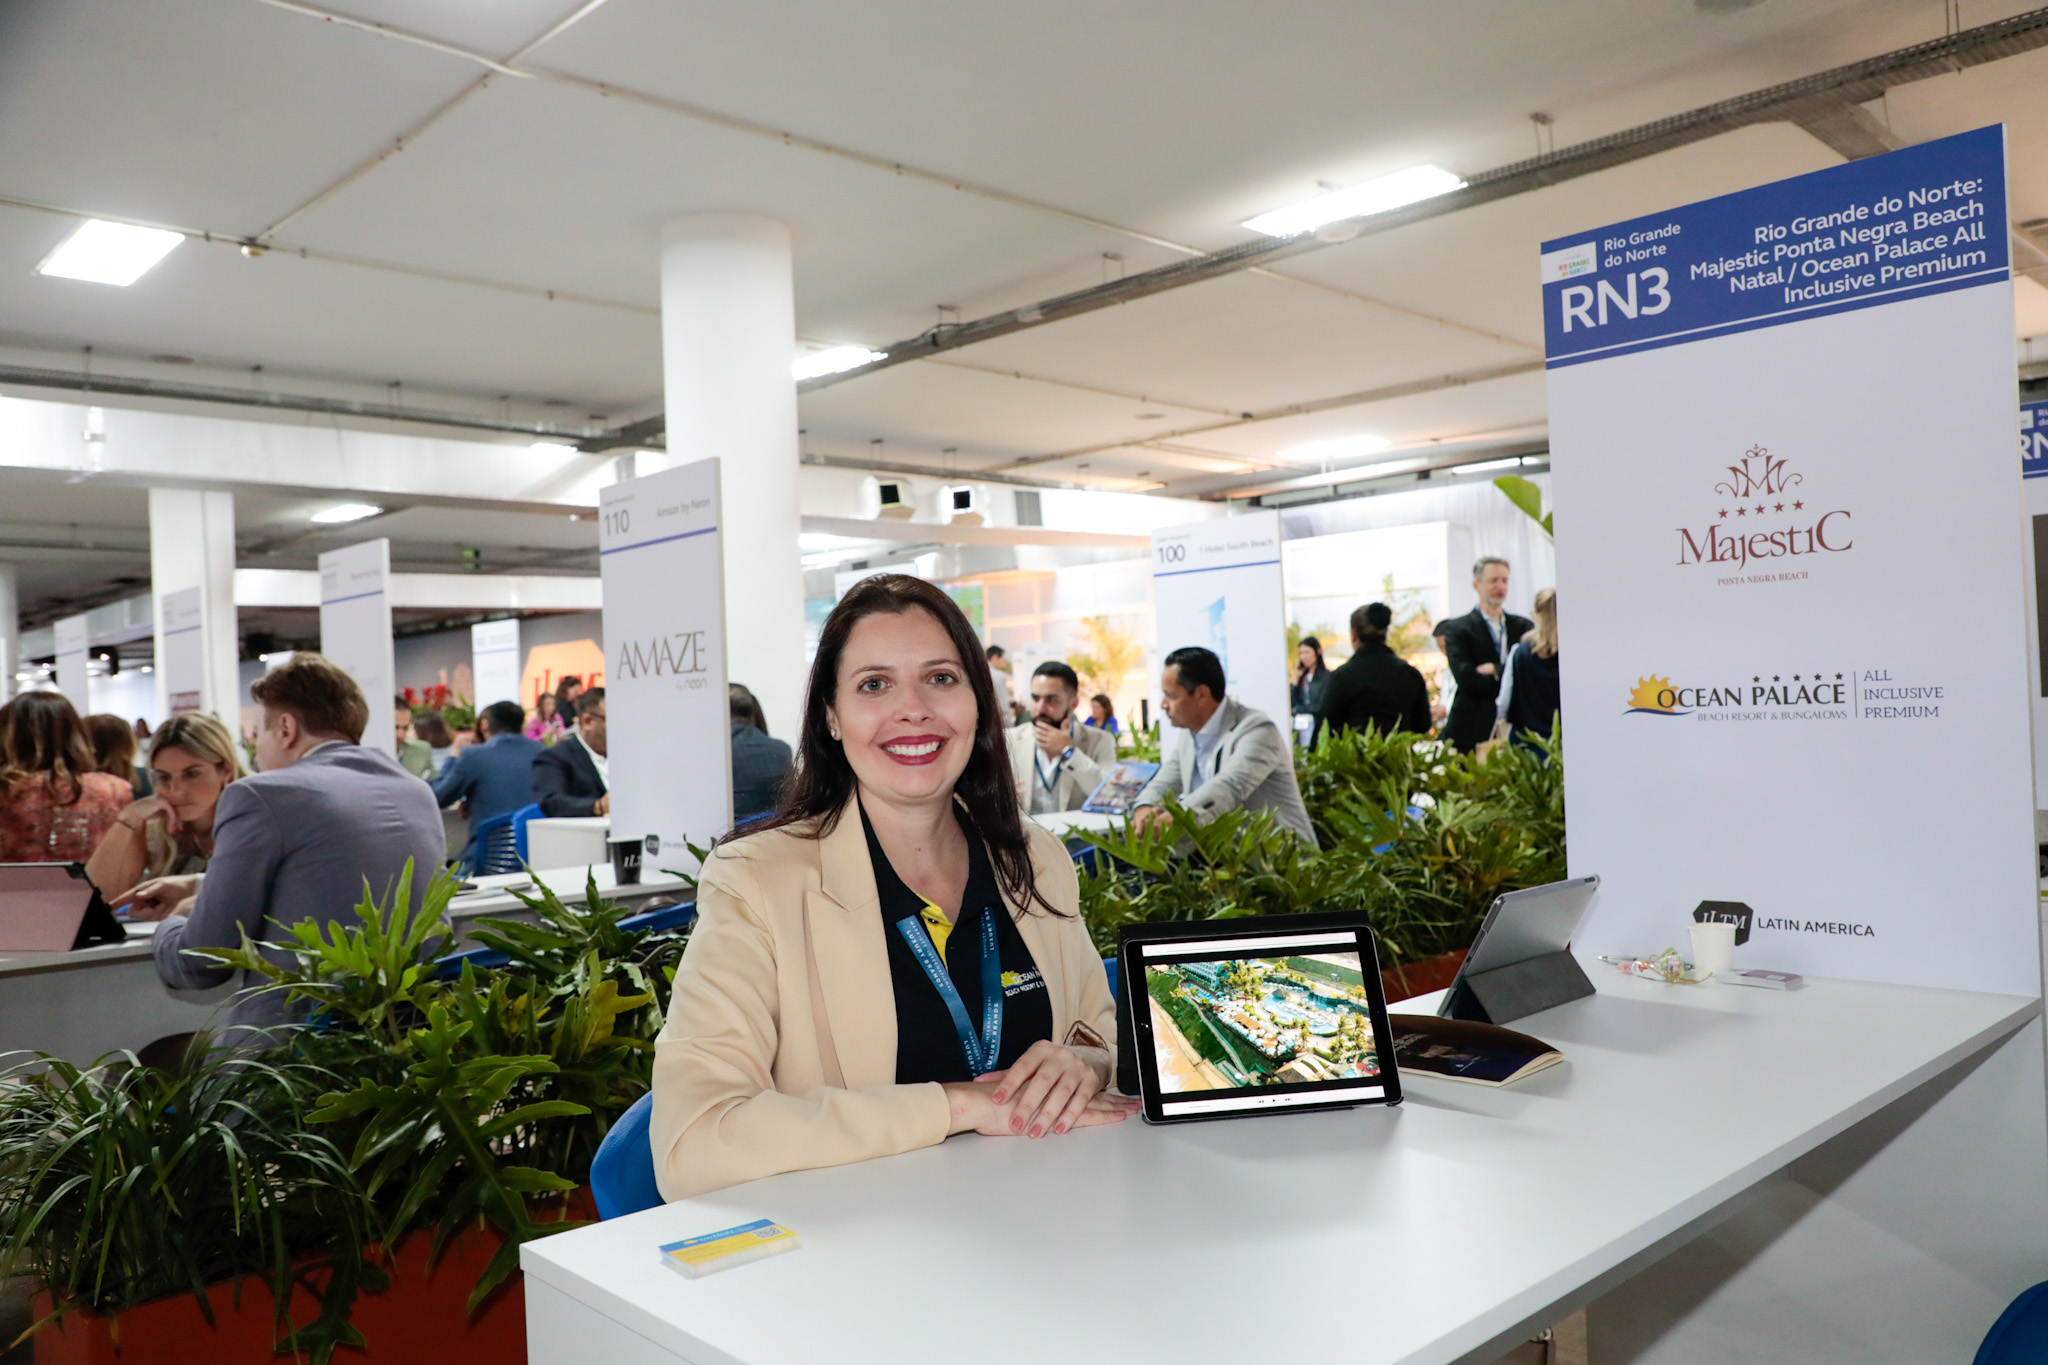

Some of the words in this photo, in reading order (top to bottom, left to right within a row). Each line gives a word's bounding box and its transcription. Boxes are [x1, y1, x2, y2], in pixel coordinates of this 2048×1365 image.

[1754, 223, 1788, 244] Rio
[1791, 203, 1869, 235] Grande
[1873, 196, 1903, 216] do
[1908, 178, 1984, 209] Norte:
[1604, 237, 1626, 252] Rio
[1629, 223, 1681, 245] Grande
[1690, 249, 1770, 281] Majestic
[1774, 235, 1836, 262] Ponta
[1840, 217, 1908, 248] Negra
[1912, 199, 1985, 231] Beach
[1604, 254, 1623, 268] do
[1626, 244, 1668, 263] Norte
[1730, 266, 1785, 293] Natal
[1801, 248, 1870, 278] Ocean
[1874, 232, 1949, 262] Palace
[1952, 221, 1987, 246] All
[1784, 272, 1876, 304] Inclusive
[1880, 250, 1987, 284] Premium
[1561, 266, 1671, 334] RN3
[604, 508, 631, 537] 110
[656, 506, 680, 518] Amaze
[680, 503, 690, 515] by
[691, 498, 712, 510] Neon
[1158, 544, 1186, 564] 100
[1204, 544, 1224, 554] Hotel
[1226, 542, 1248, 551] South
[1250, 538, 1274, 548] Beach
[1717, 576, 1746, 586] PONTA
[1747, 574, 1777, 584] NEGRA
[1778, 571, 1809, 582] BEACH
[617, 630, 707, 680] AMAZE
[1863, 669, 1892, 682] ALL
[1656, 686, 1742, 708] OCEAN
[1752, 683, 1846, 706] PALACE
[1864, 686, 1944, 701] INCLUSIVE
[1697, 712, 1730, 722] BEACH
[1731, 711, 1768, 721] RESORT
[1770, 712, 1778, 720] &
[1780, 710, 1848, 720] BUNGALOWS
[1864, 706, 1940, 720] PREMIUM
[986, 923, 994, 950] LUXURY
[1757, 917, 1800, 932] LATIN
[1803, 920, 1876, 937] AMERICA
[906, 930, 926, 957] LUXURY
[924, 960, 944, 988] BRANDS
[910, 920, 928, 948] MARRIOTT
[926, 950, 952, 992] INTERNATIONAL
[1012, 971, 1036, 984] OCEAN
[964, 1040, 976, 1070] LUXURY
[968, 1030, 980, 1060] MARRIOTT
[986, 1038, 996, 1070] LUXURY
